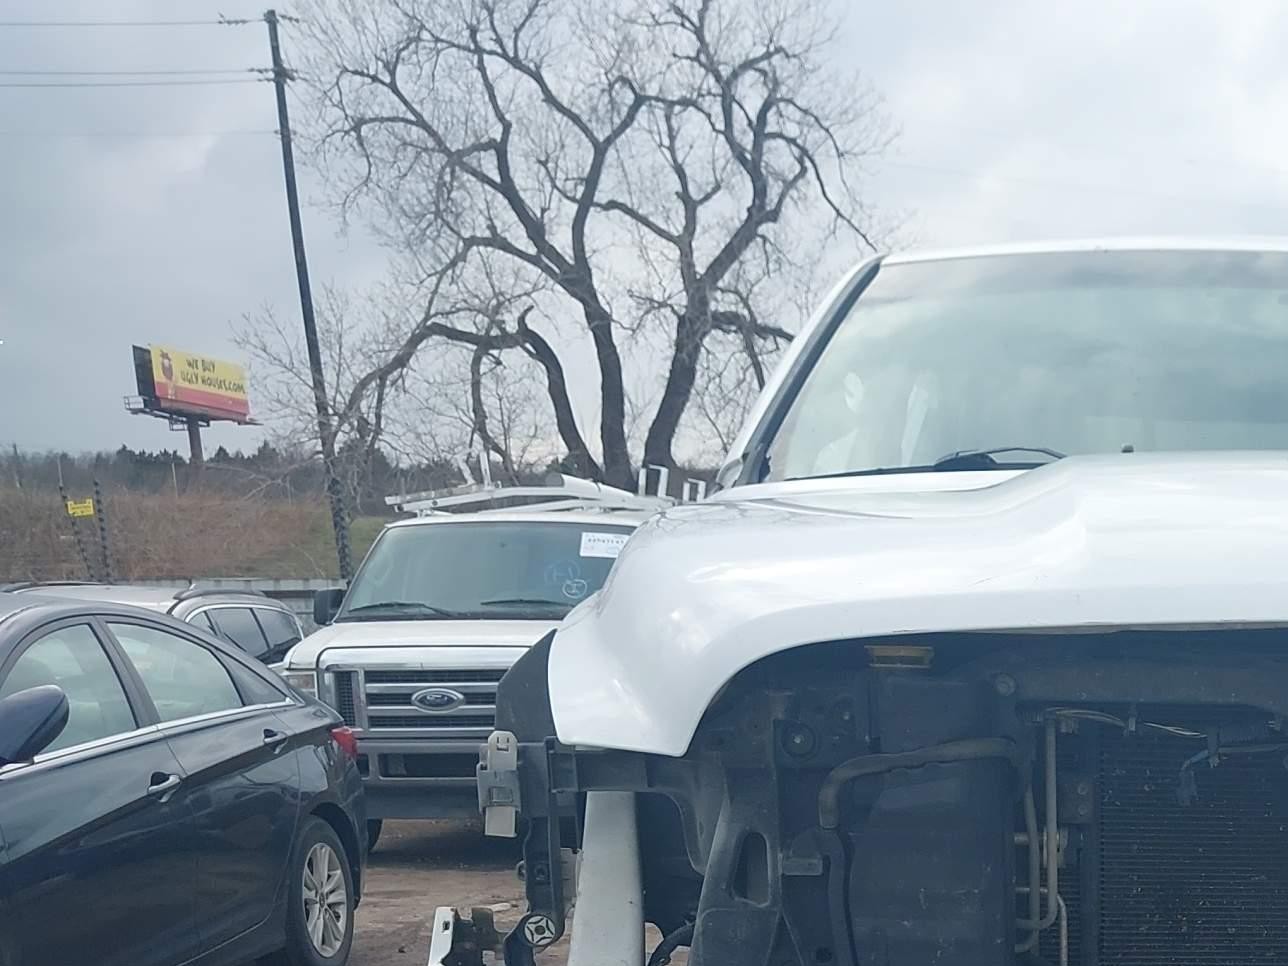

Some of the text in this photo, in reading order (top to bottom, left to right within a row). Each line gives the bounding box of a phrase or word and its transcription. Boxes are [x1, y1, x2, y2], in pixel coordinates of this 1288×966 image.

[186, 358, 216, 373] WE BUY
[180, 370, 199, 386] UGLY
